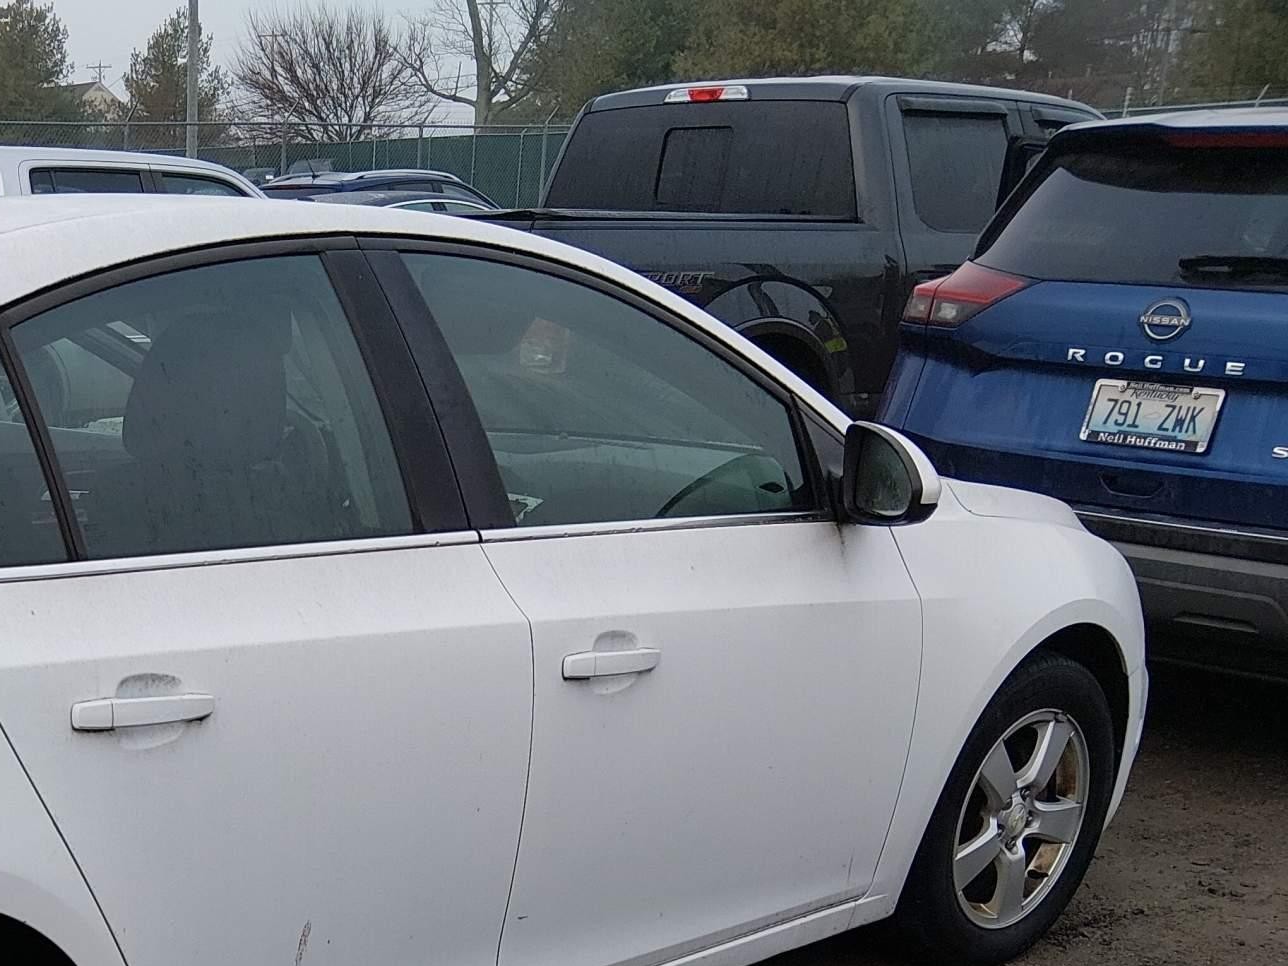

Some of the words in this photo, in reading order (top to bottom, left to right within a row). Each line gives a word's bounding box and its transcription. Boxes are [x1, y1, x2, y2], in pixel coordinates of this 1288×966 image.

[641, 271, 715, 286] PORT
[1139, 315, 1191, 326] NISSAN
[1067, 348, 1246, 376] ROGUE
[1102, 398, 1142, 429] 791
[1157, 403, 1205, 434] ZWK
[1097, 432, 1125, 443] Neil
[1126, 435, 1186, 450] Huffman
